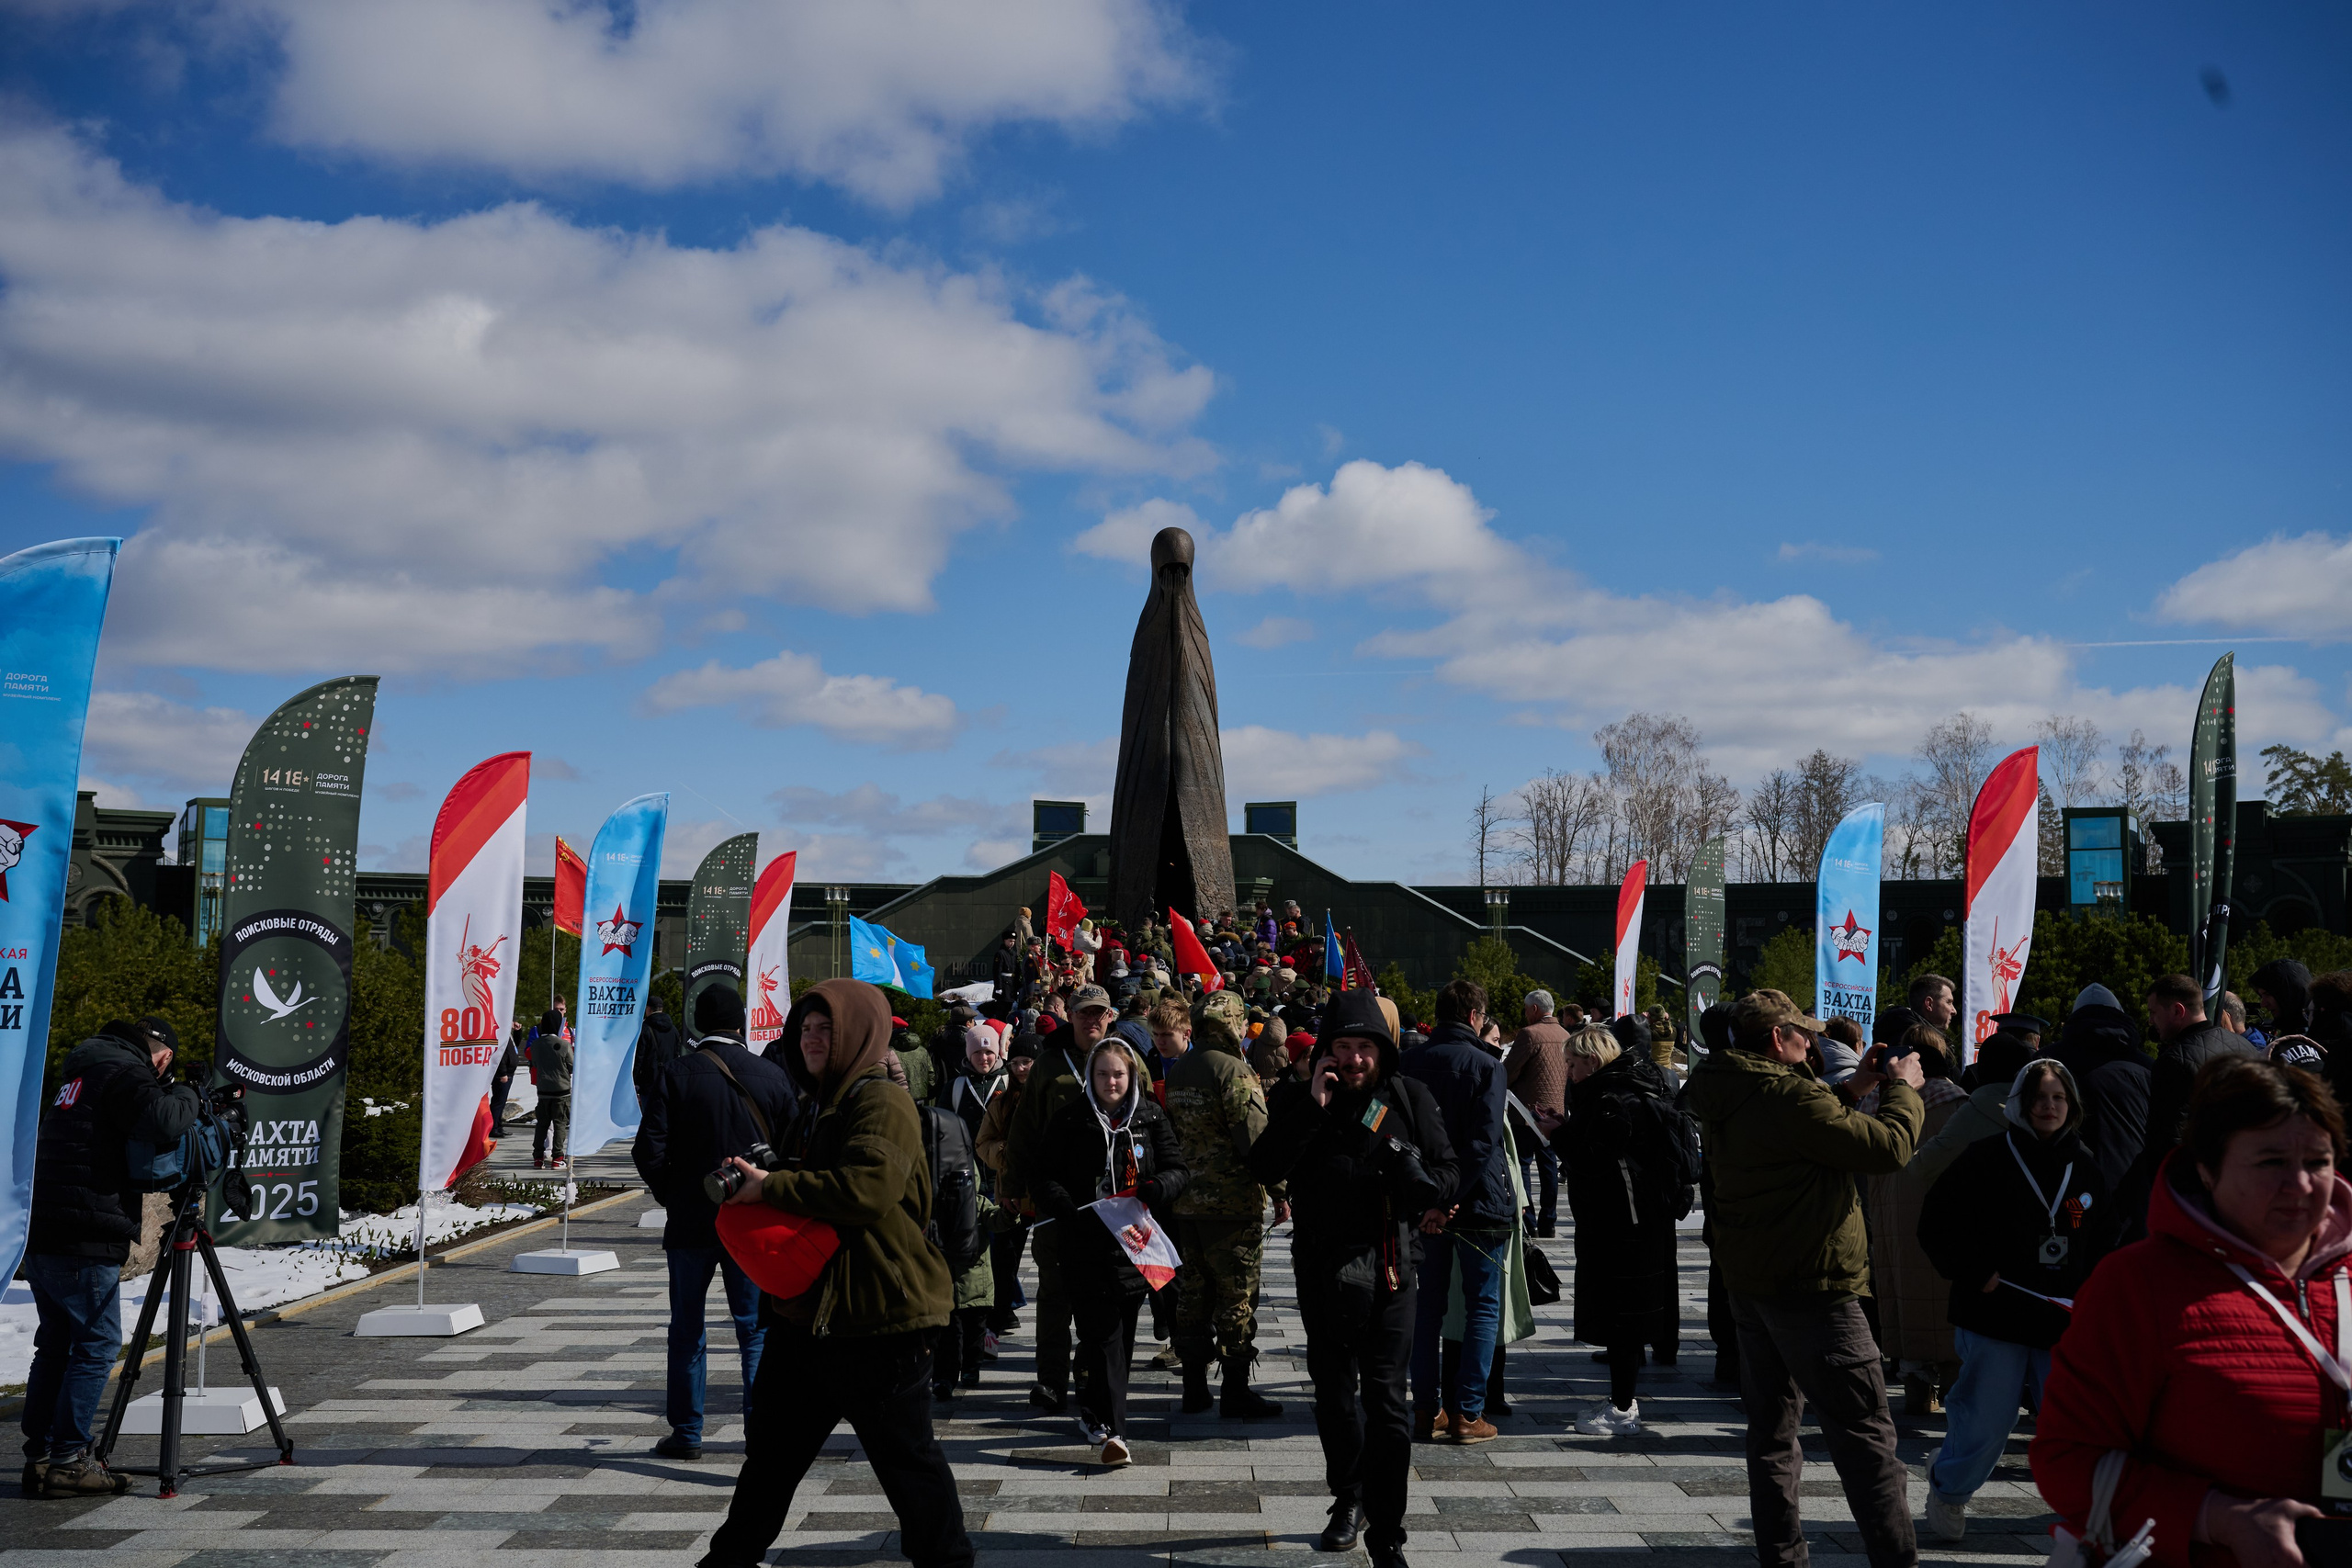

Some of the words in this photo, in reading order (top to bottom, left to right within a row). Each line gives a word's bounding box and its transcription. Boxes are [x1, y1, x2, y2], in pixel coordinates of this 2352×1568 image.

[6, 672, 48, 682] ДОРОГА
[4, 682, 50, 693] ПАМЯТИ
[315, 781, 350, 791] ПАМЯТИ
[316, 773, 349, 782] ДОРОГА
[234, 918, 296, 942] ПОИСКОВЫЕ
[298, 919, 340, 945] ОТРЯДЫ
[589, 976, 639, 985] ВСЕРОССИЙСКАЯ
[691, 964, 723, 978] ПОИСКОВЫЕ
[588, 986, 637, 1002] ВАХТА
[1824, 981, 1873, 993] ВСЕРОССИЙСКАЯ
[587, 1003, 636, 1015] ПАМЯТИ
[1823, 990, 1872, 1011] ВАХТА
[440, 1007, 481, 1042] 80
[751, 1008, 765, 1027] 80
[439, 1047, 498, 1066] ПОБЕД
[2279, 1044, 2323, 1064] MIAMI
[226, 1057, 291, 1088] МОСКОВСКОЙ
[293, 1057, 336, 1085] ОБЛАСТИ
[52, 1081, 82, 1106] ВЦ
[242, 1120, 321, 1145] АХТА
[1387, 1266, 1398, 1291] Canon
